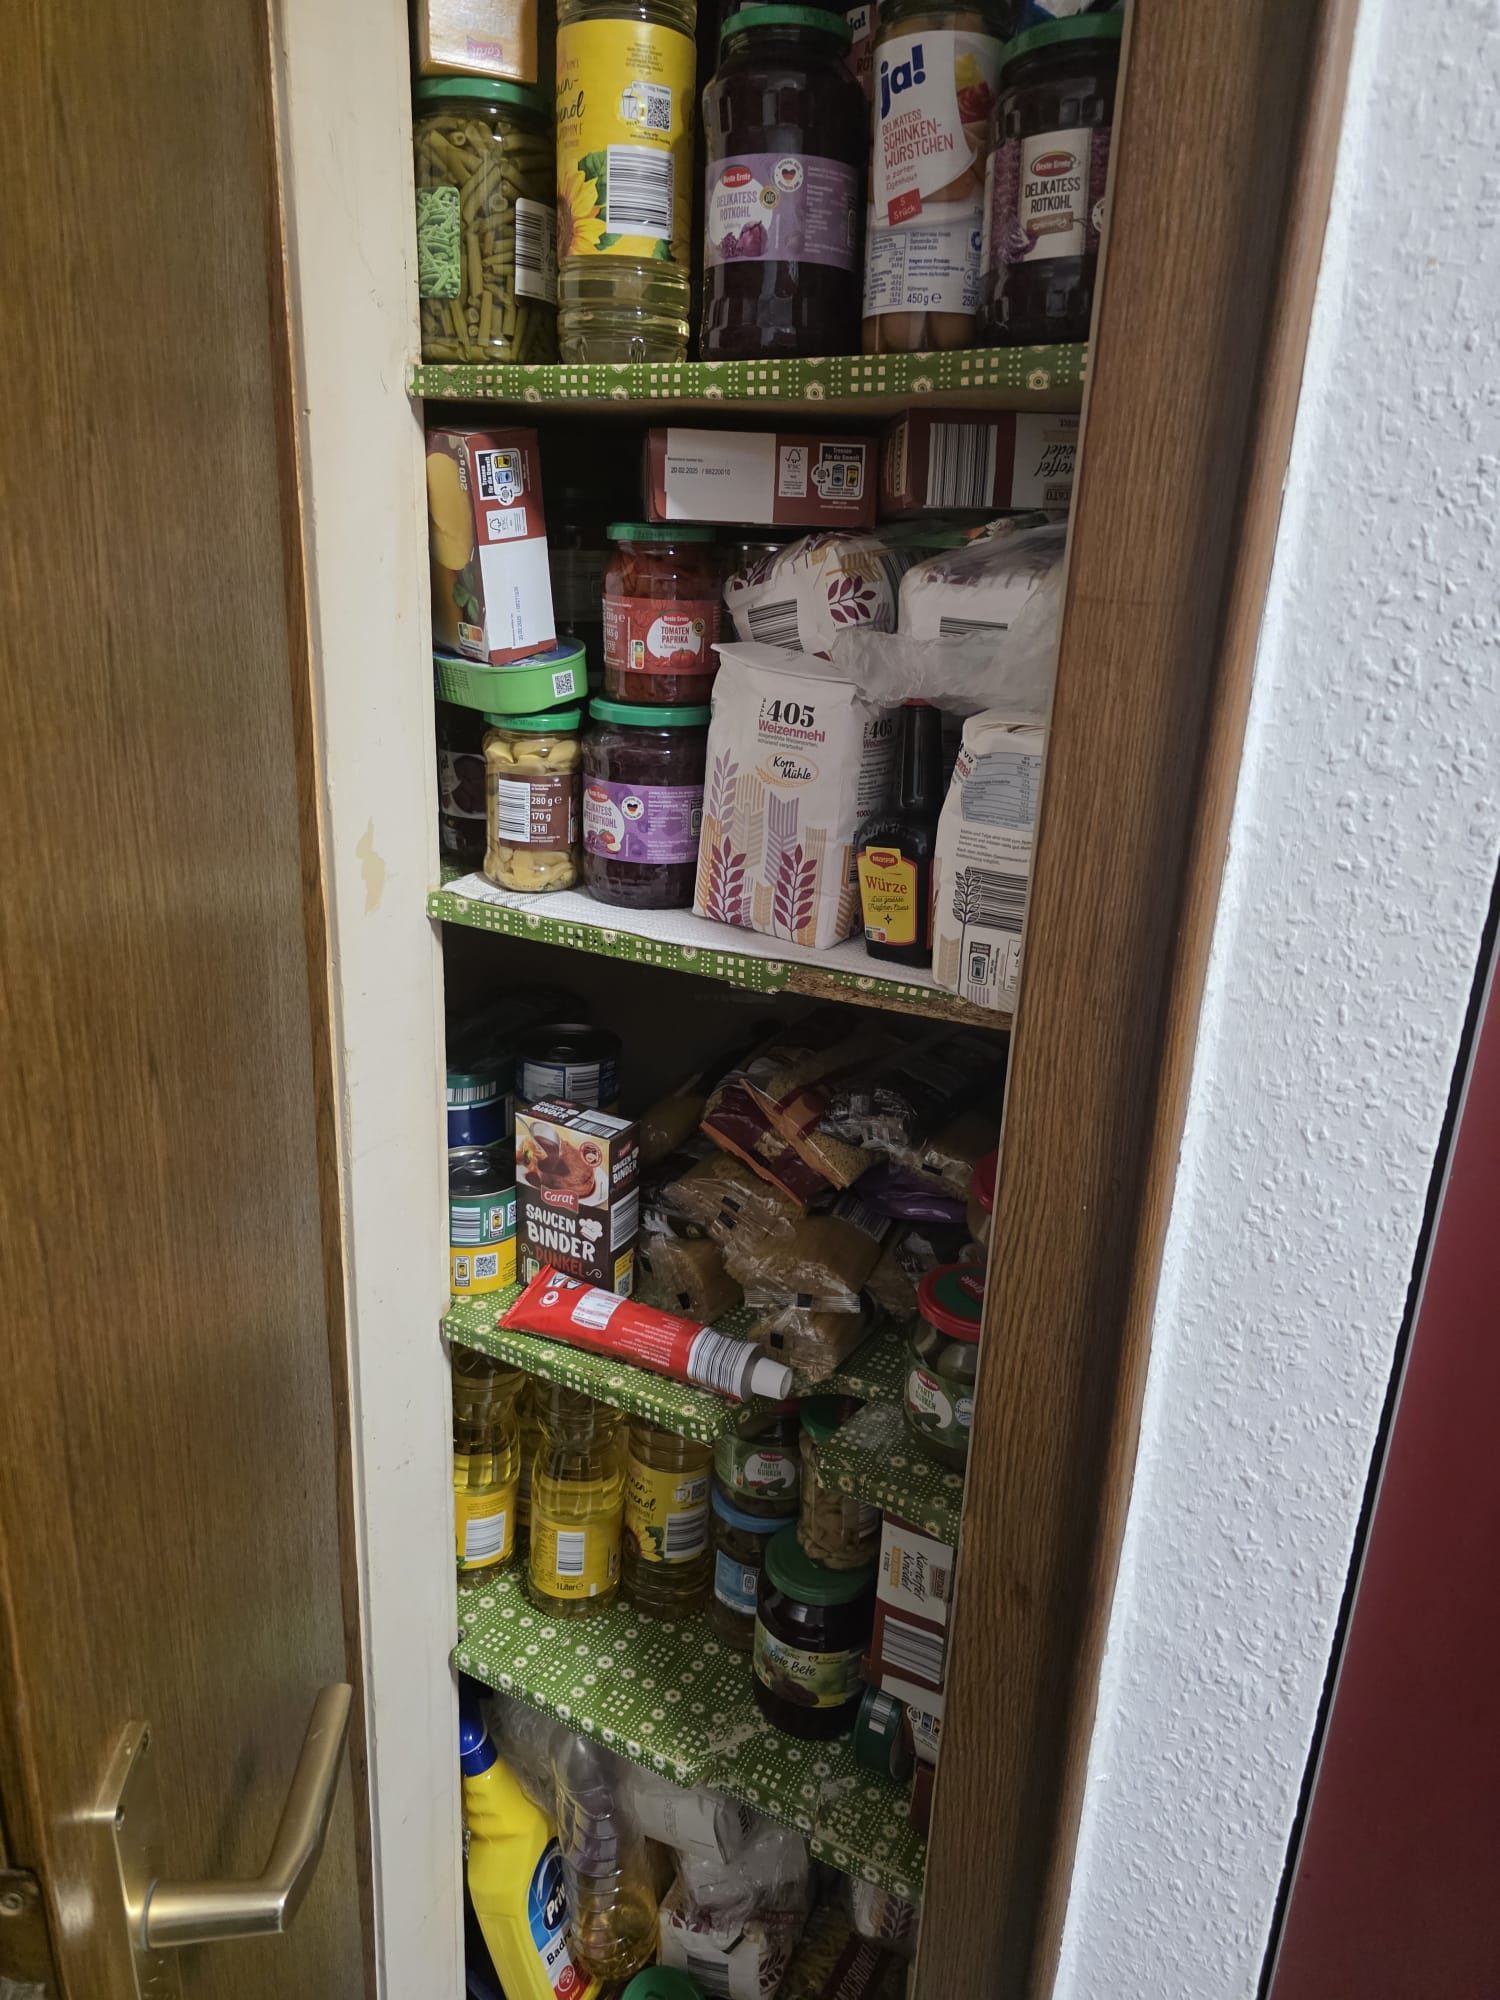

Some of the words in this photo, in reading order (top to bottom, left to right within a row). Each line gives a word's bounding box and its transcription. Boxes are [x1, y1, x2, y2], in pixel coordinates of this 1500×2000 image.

[881, 43, 926, 120] ja!
[882, 108, 922, 136] DELIKATESS
[884, 118, 942, 153] SCHINKEN-
[1025, 176, 1081, 199] DELIKATESS
[717, 190, 758, 208] DELIKATESS
[1030, 195, 1072, 214] ROTKOHL
[720, 206, 751, 221] ROTKOHL
[893, 204, 916, 221] Stück
[907, 294, 922, 304] 450
[923, 296, 929, 306] g
[459, 467, 468, 491] 200
[661, 626, 690, 636] TOMATEN
[662, 636, 689, 644] PAPRIKA
[766, 699, 816, 728] 405
[758, 720, 826, 743] Weizenmehl
[869, 718, 893, 739] 405
[773, 755, 796, 768] Korn
[782, 767, 812, 780] Mühle
[531, 796, 546, 805] 280
[547, 798, 553, 807] g
[531, 812, 545, 820] 170
[545, 814, 552, 823] g
[531, 825, 546, 833] 314
[865, 875, 908, 895] Würze
[612, 1159, 638, 1185] BINDER
[543, 1190, 575, 1206] Carat
[525, 1203, 576, 1235] SAUCEN
[526, 1220, 596, 1263] BINDER
[535, 1244, 586, 1278] DUNKEL
[901, 1551, 915, 1593] Knödel
[913, 1551, 929, 1603] Kartoffel
[790, 1660, 817, 1677] Bete
